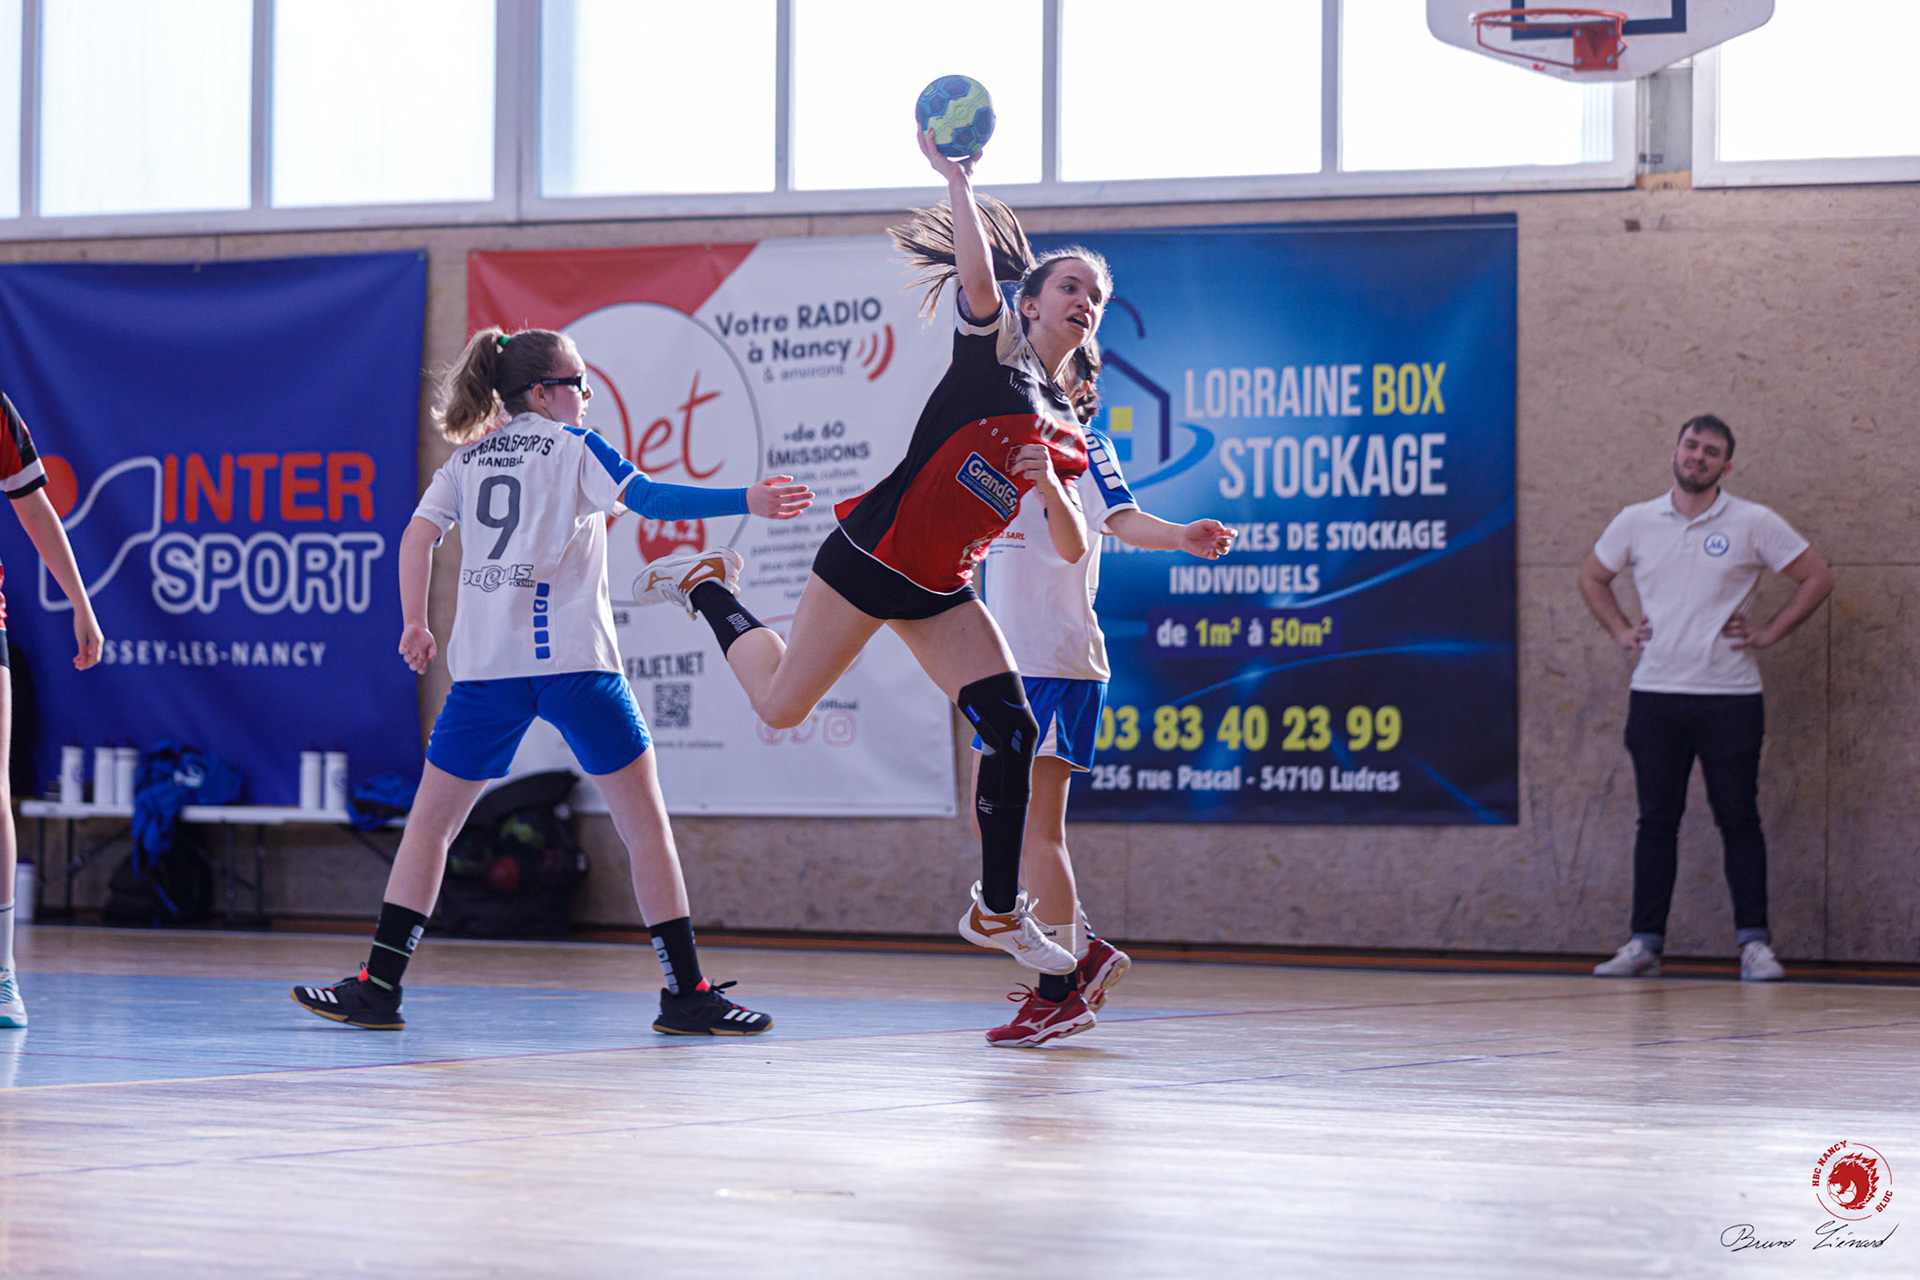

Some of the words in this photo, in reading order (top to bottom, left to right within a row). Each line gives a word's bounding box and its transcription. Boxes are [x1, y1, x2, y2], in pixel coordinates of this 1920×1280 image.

[714, 310, 788, 337] Votre
[797, 297, 882, 330] RADIO
[748, 340, 764, 364] à
[771, 337, 852, 363] Nancy
[1184, 364, 1363, 419] LORRAINE
[1371, 362, 1447, 416] BOX
[820, 419, 846, 440] 60
[1218, 432, 1447, 499] STOCKAGE
[163, 452, 376, 524] INTER
[475, 474, 522, 560] 9
[1286, 521, 1319, 551] DE
[1326, 519, 1448, 551] STOCKAGE
[151, 531, 385, 615] SPORT
[1169, 564, 1320, 595] INDIVIDUELS
[1156, 618, 1188, 648] de
[1194, 617, 1241, 647] 1m²
[1247, 618, 1264, 647] à
[1269, 616, 1333, 647] 50m²
[103, 639, 327, 668] SSEY-LES-NANCY
[1095, 705, 1141, 751] 03
[1152, 705, 1205, 751] 83
[1216, 705, 1269, 751] 40
[1281, 705, 1332, 751] 23
[1345, 705, 1401, 751] 99
[1091, 764, 1132, 790] 256
[1137, 768, 1172, 791] rue
[1177, 764, 1241, 791] Pascal
[1259, 764, 1325, 791] 54710
[1329, 764, 1400, 792] Ludres
